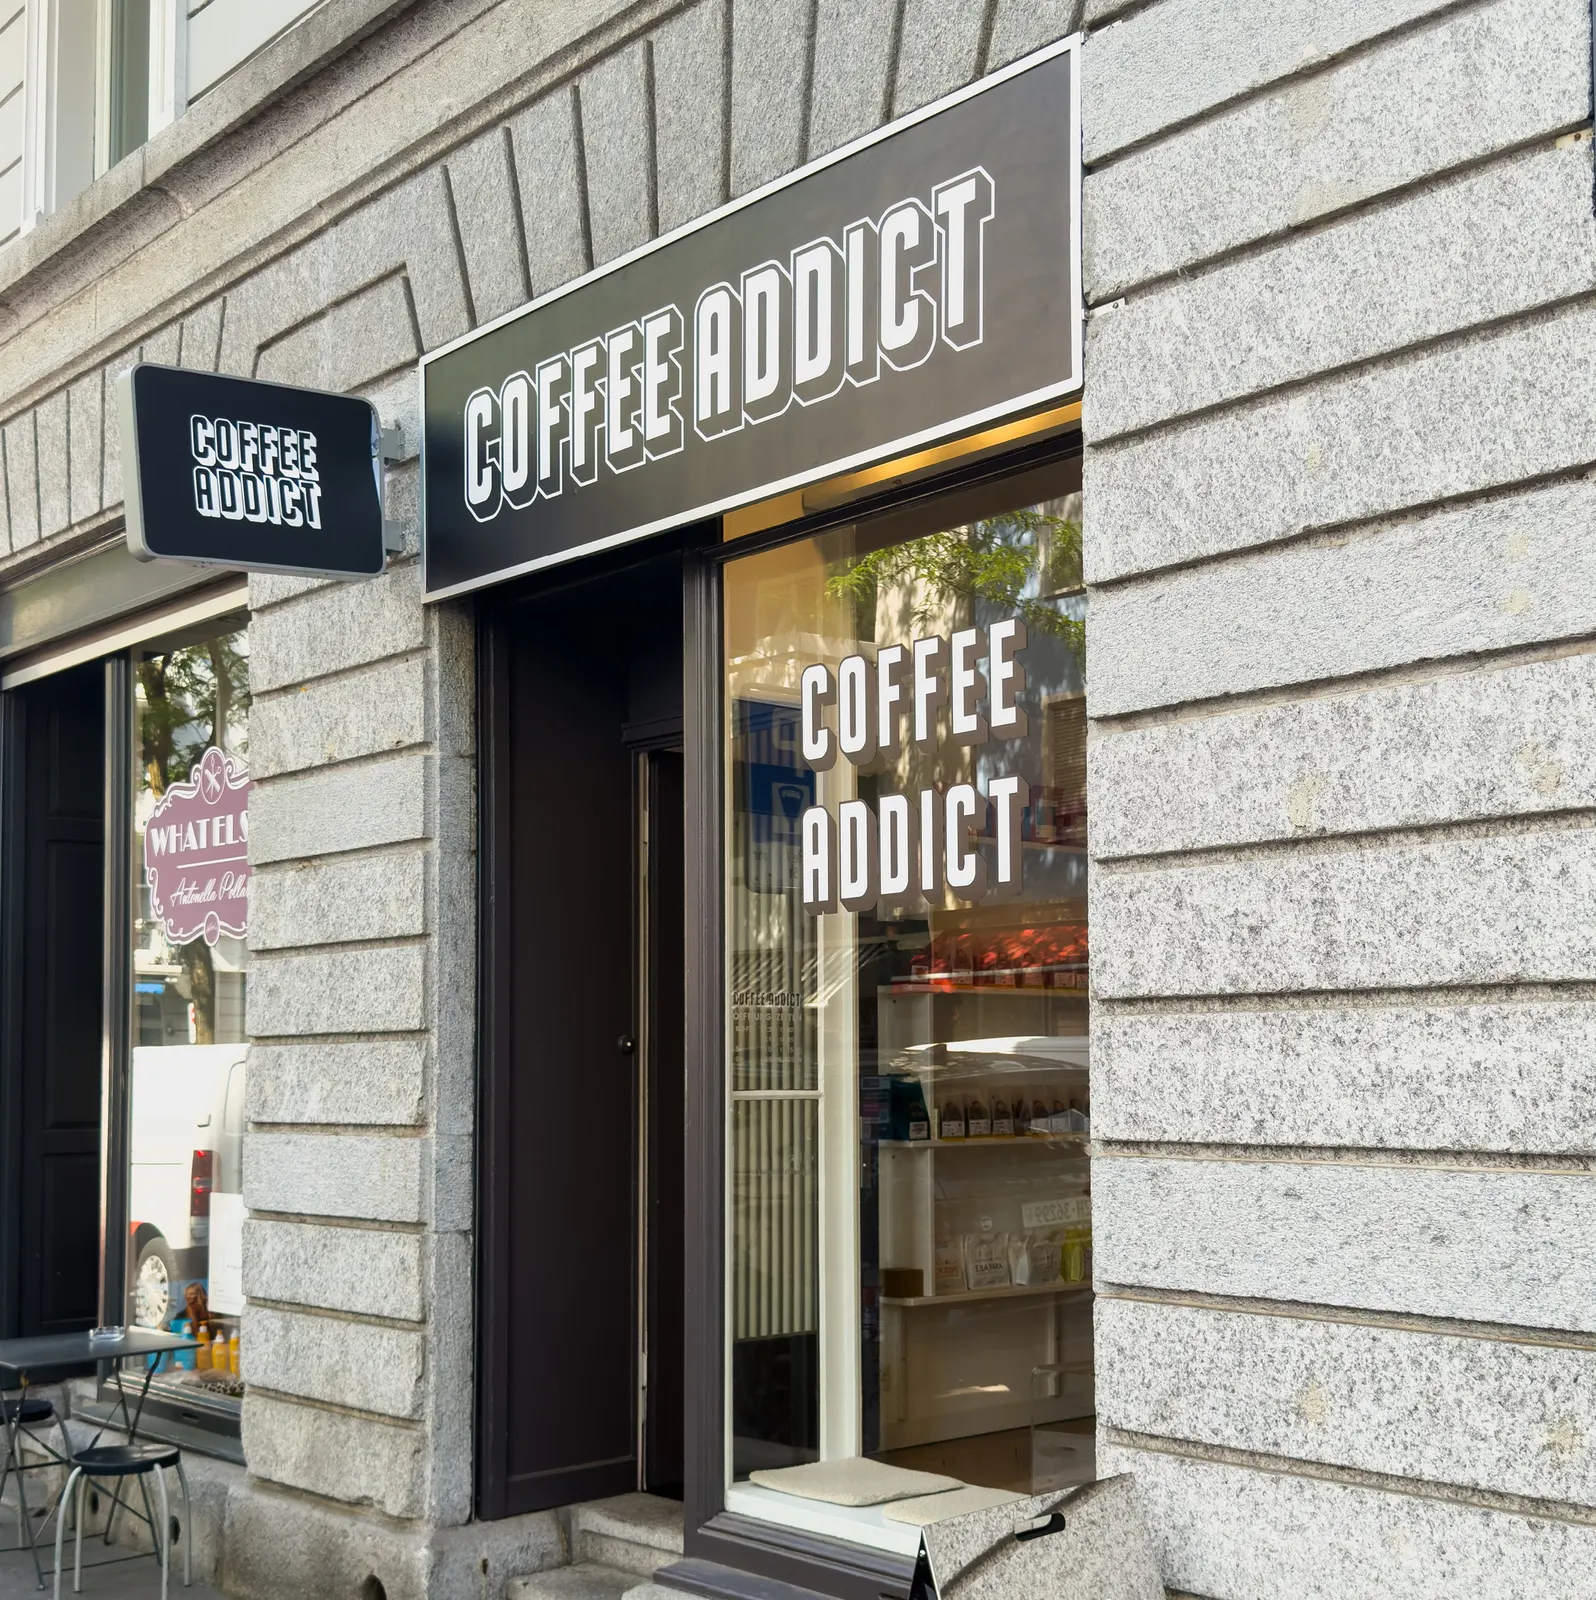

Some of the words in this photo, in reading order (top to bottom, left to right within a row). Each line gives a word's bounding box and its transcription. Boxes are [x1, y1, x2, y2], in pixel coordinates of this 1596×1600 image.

[464, 303, 684, 523] COFFEE
[694, 165, 996, 443] ADDICT
[190, 414, 320, 481] COFFEE
[192, 466, 322, 530] ADDICT
[801, 616, 1027, 771] COFFEE
[801, 774, 1029, 915] ADDICT
[170, 876, 218, 907] Antonella
[733, 992, 766, 1006] COFFEE
[767, 992, 801, 1007] ADDICT
